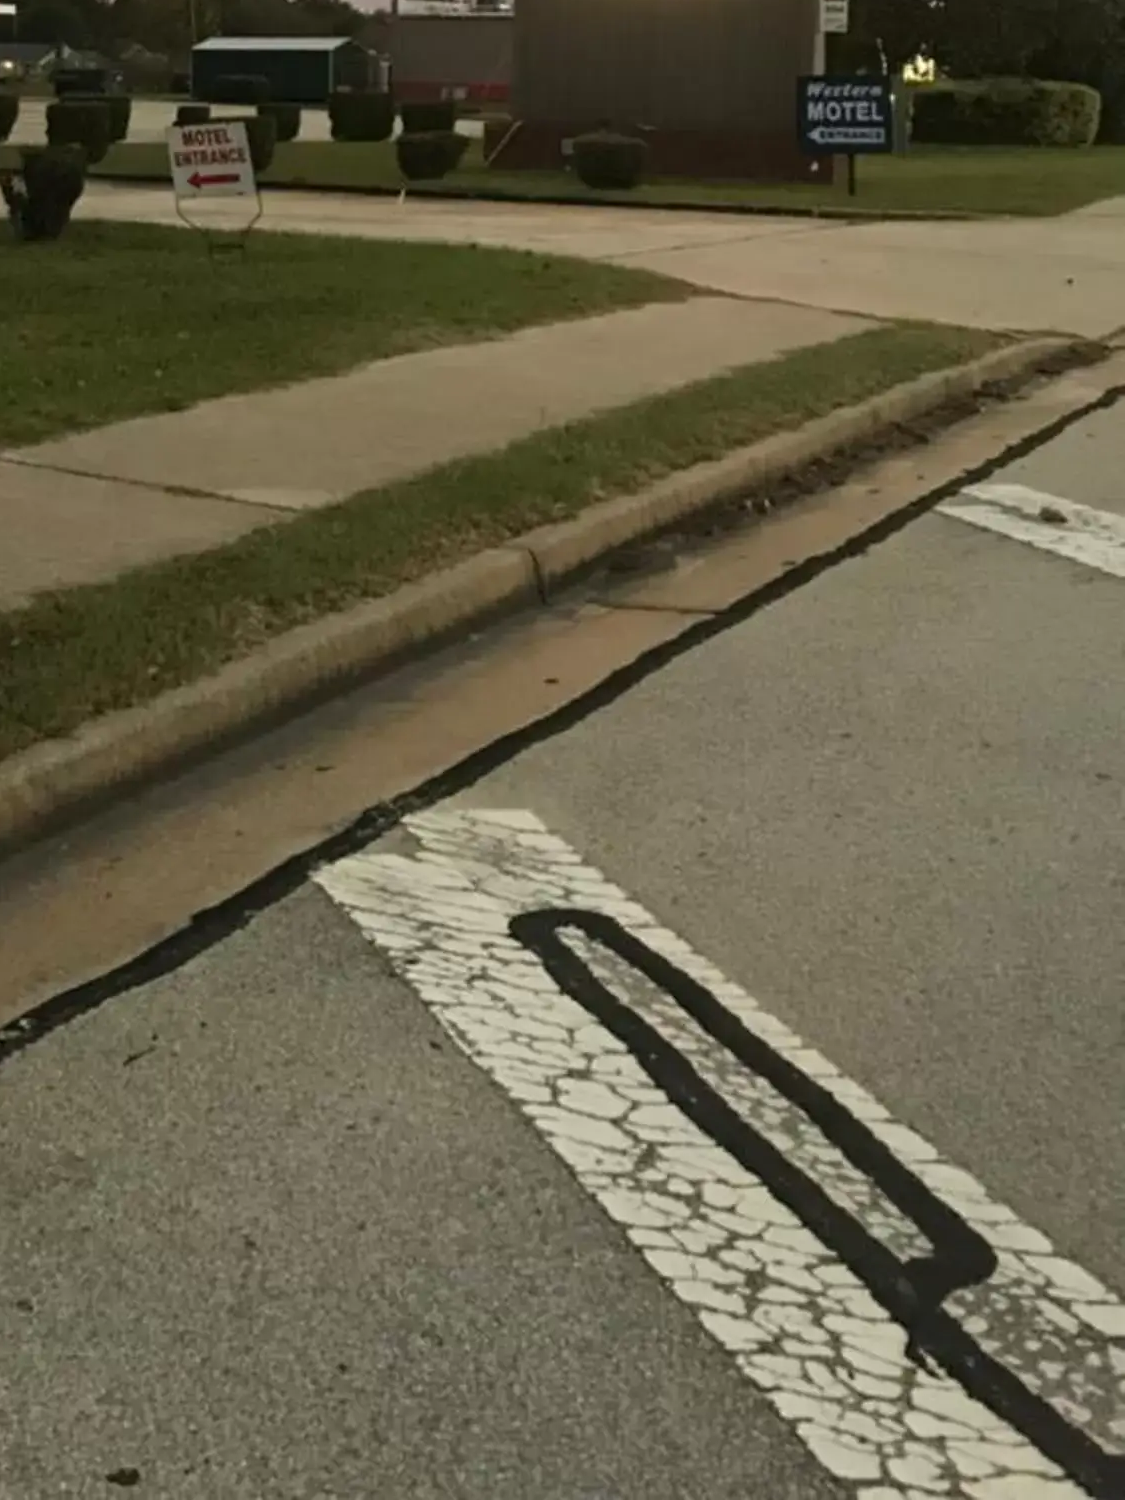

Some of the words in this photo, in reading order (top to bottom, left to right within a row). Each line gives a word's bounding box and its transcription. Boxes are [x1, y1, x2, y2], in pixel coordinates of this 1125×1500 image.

[807, 101, 884, 121] MOTEL
[181, 128, 231, 146] MOTEL
[175, 147, 247, 167] ENTRANCE
